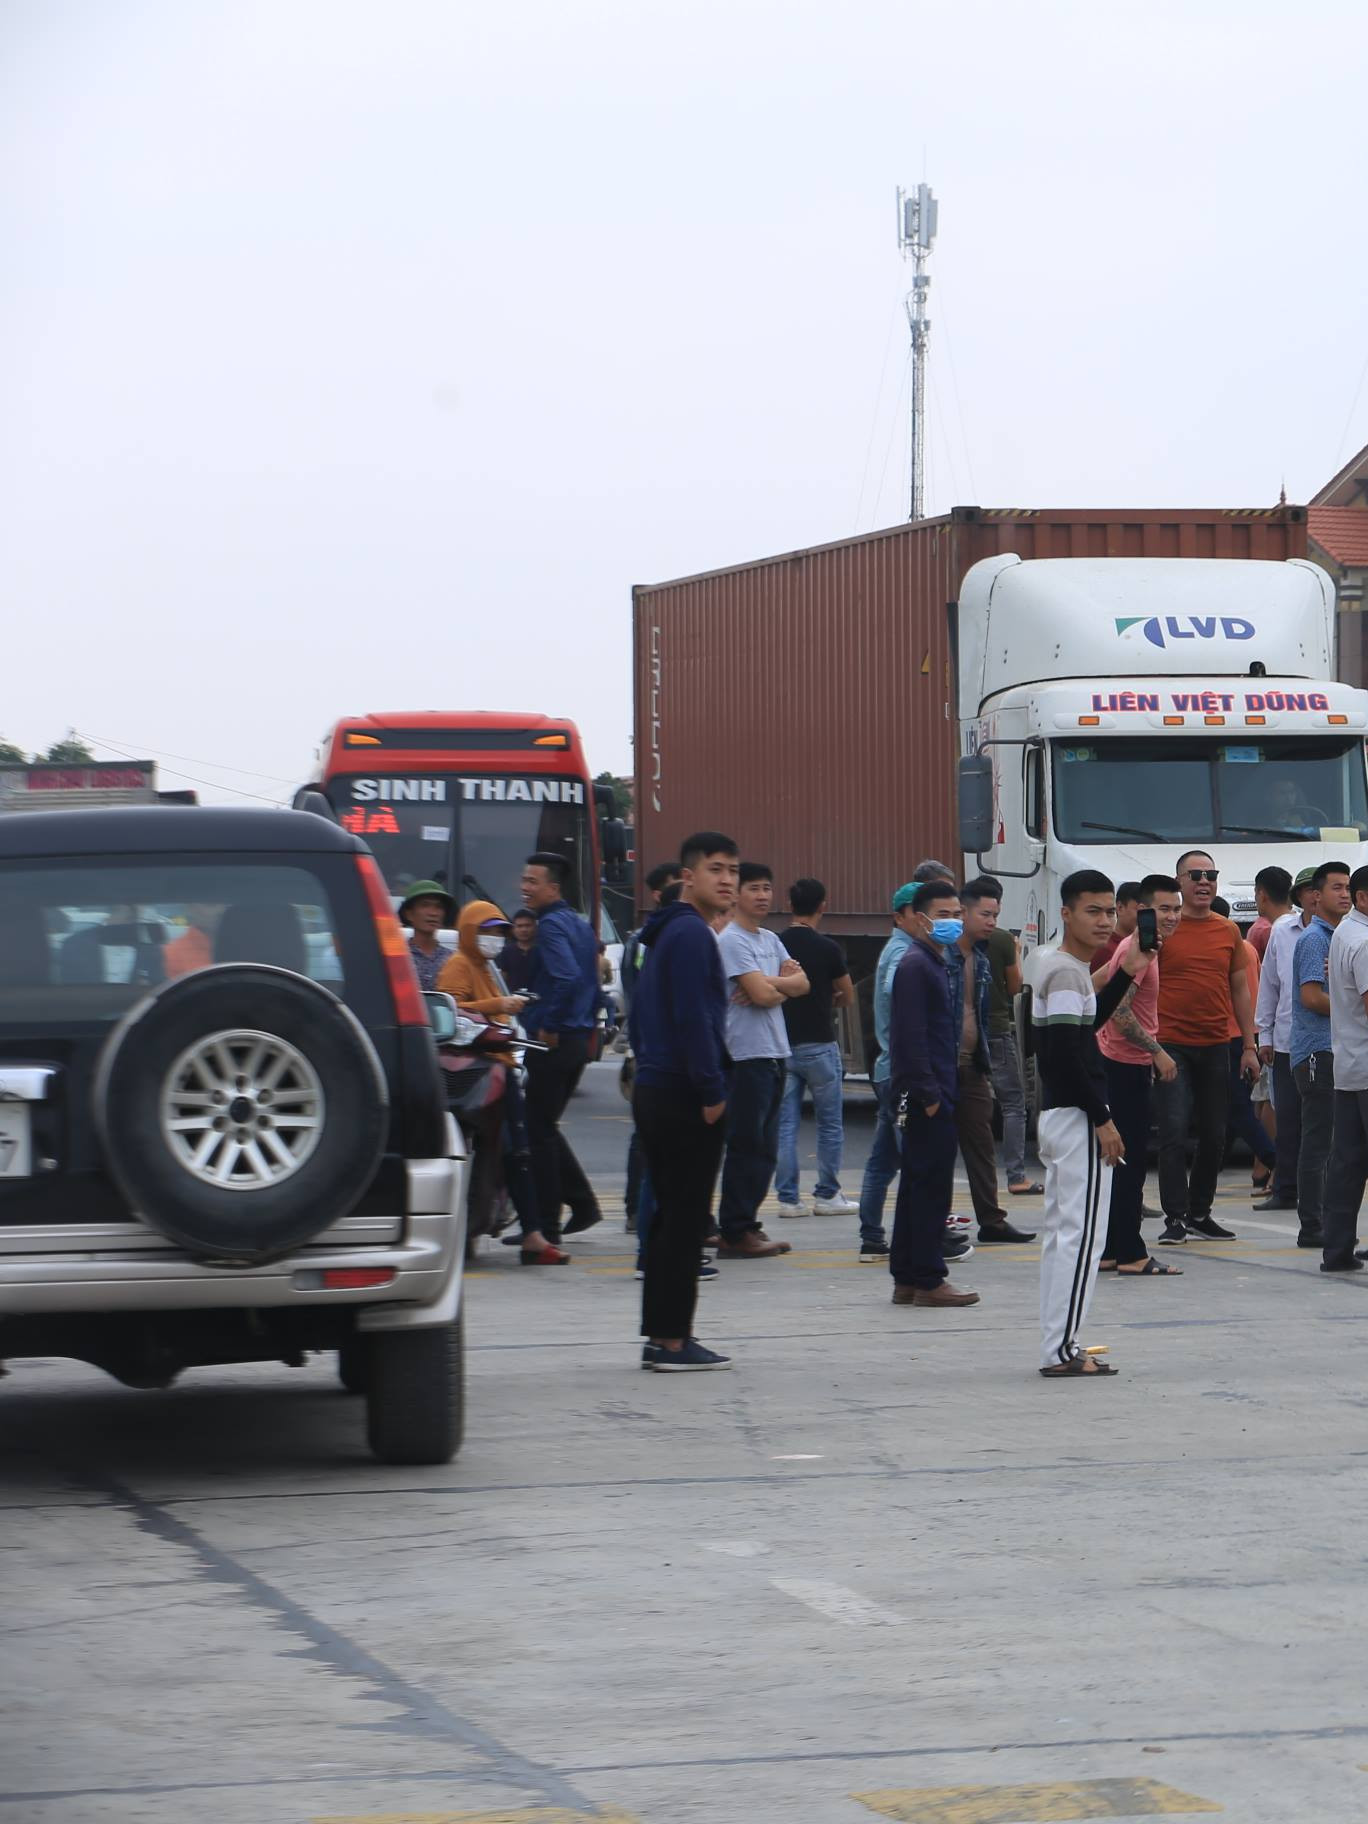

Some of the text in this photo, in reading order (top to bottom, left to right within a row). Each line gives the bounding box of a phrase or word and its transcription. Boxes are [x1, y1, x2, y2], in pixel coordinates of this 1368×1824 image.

[1165, 616, 1256, 640] LVD
[1092, 691, 1329, 715] LIÊN VIỆT DŨNG
[351, 778, 584, 804] SINH THANH
